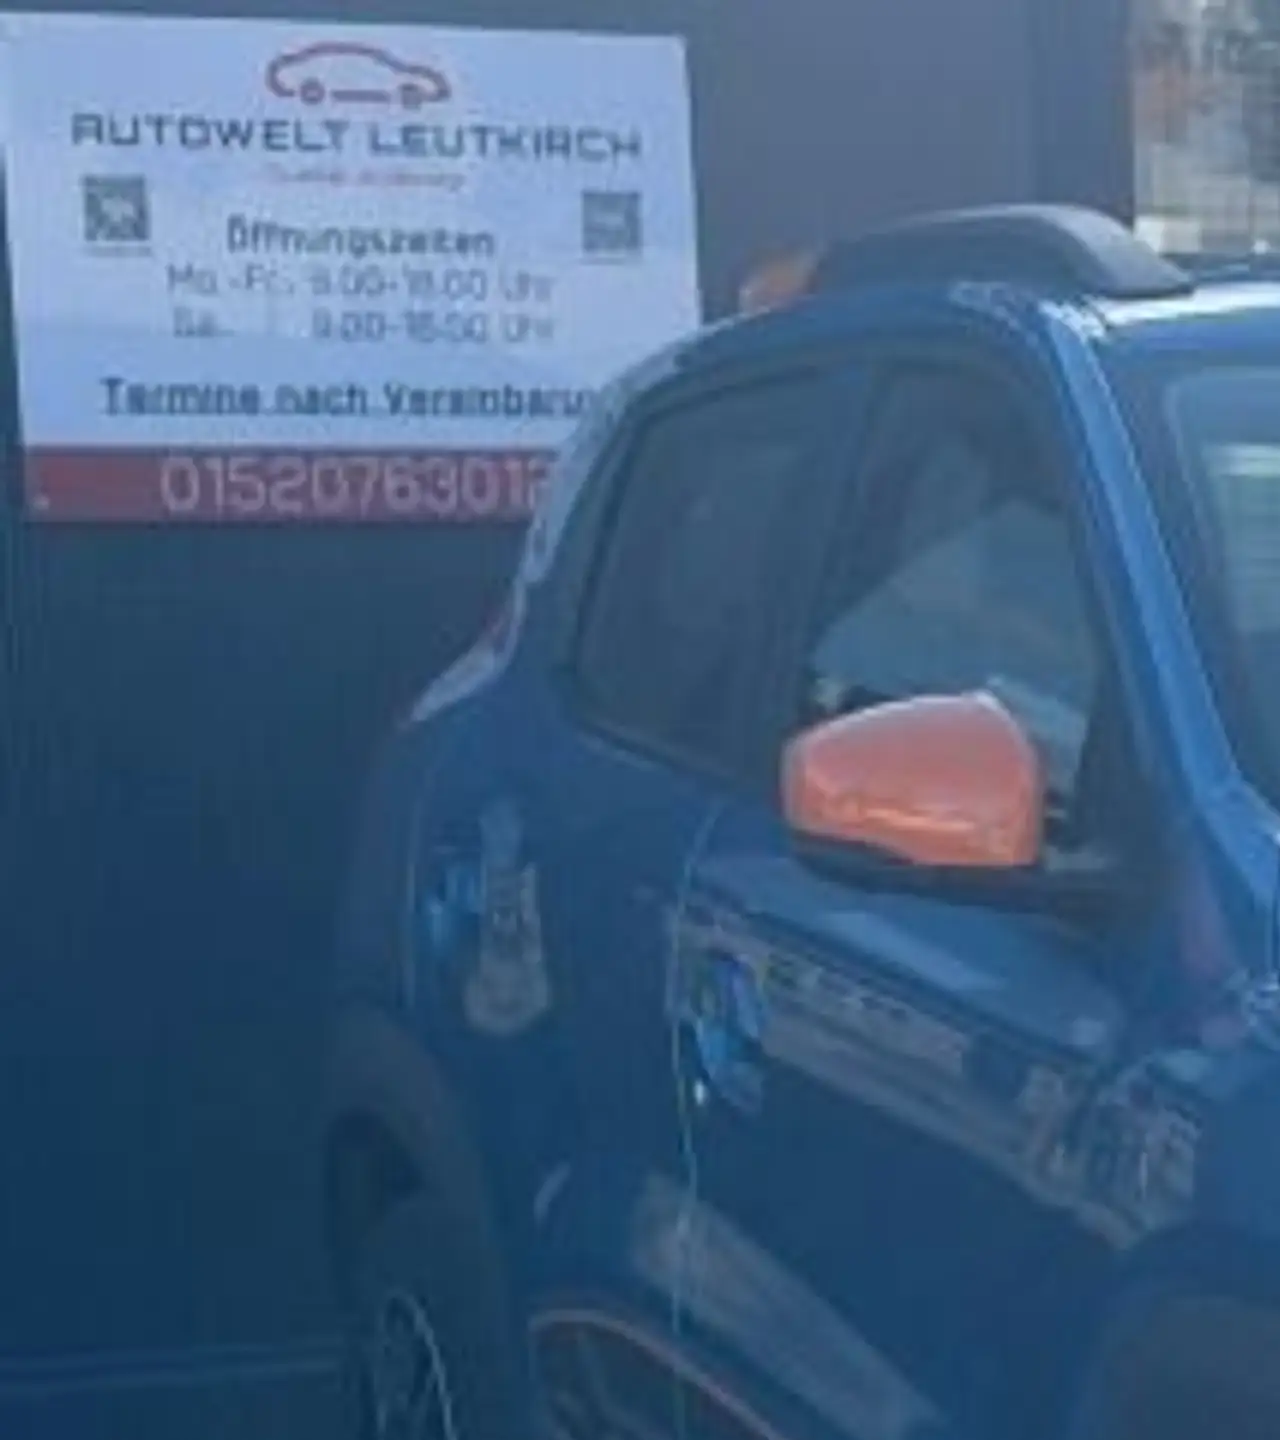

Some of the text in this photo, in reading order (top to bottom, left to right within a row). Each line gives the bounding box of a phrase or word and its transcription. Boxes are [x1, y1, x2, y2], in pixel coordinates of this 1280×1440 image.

[71, 112, 642, 160] AUTOWELT LEUTKIRCH
[226, 213, 494, 258] Öffnungszeiten
[105, 378, 584, 418] Termine nach Vereinbaru
